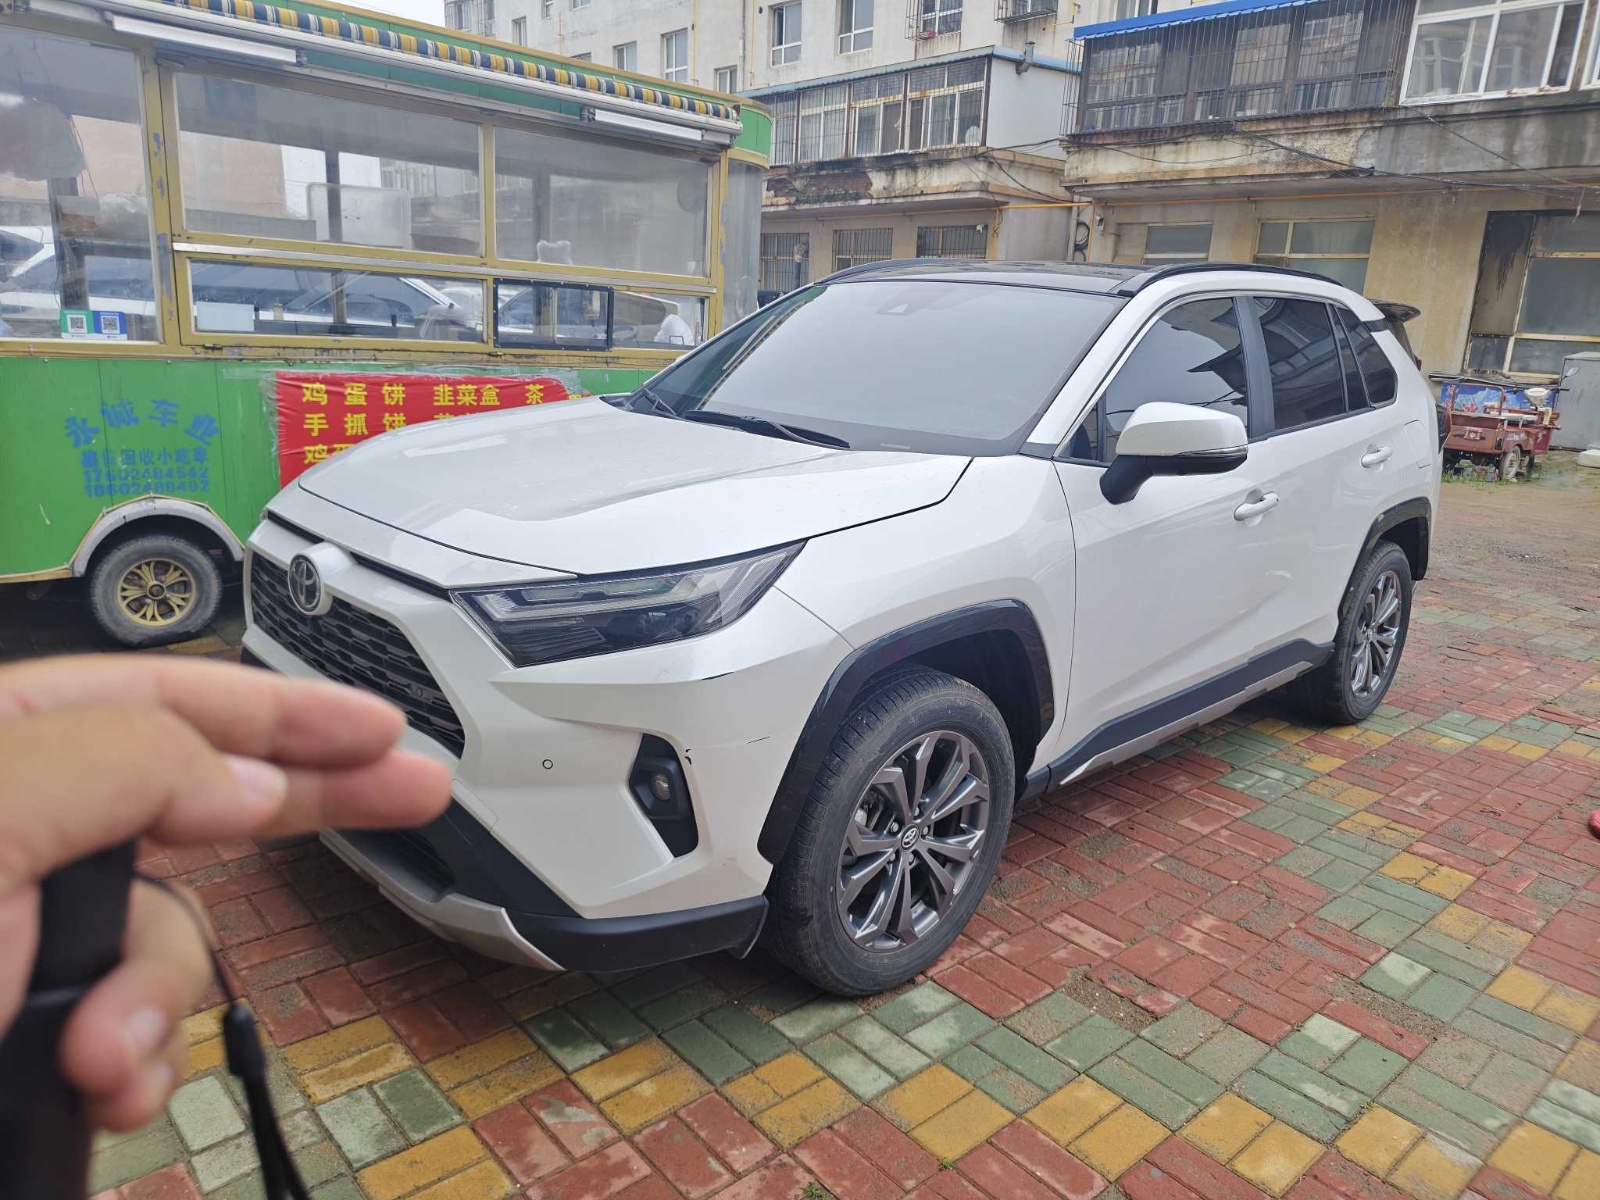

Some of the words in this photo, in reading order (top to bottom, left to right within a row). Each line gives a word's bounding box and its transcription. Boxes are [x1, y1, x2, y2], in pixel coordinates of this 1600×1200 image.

[301, 382, 405, 406] 鸡蛋饼
[433, 384, 500, 406] 韭菜盒
[303, 413, 406, 437] 手抓饼
